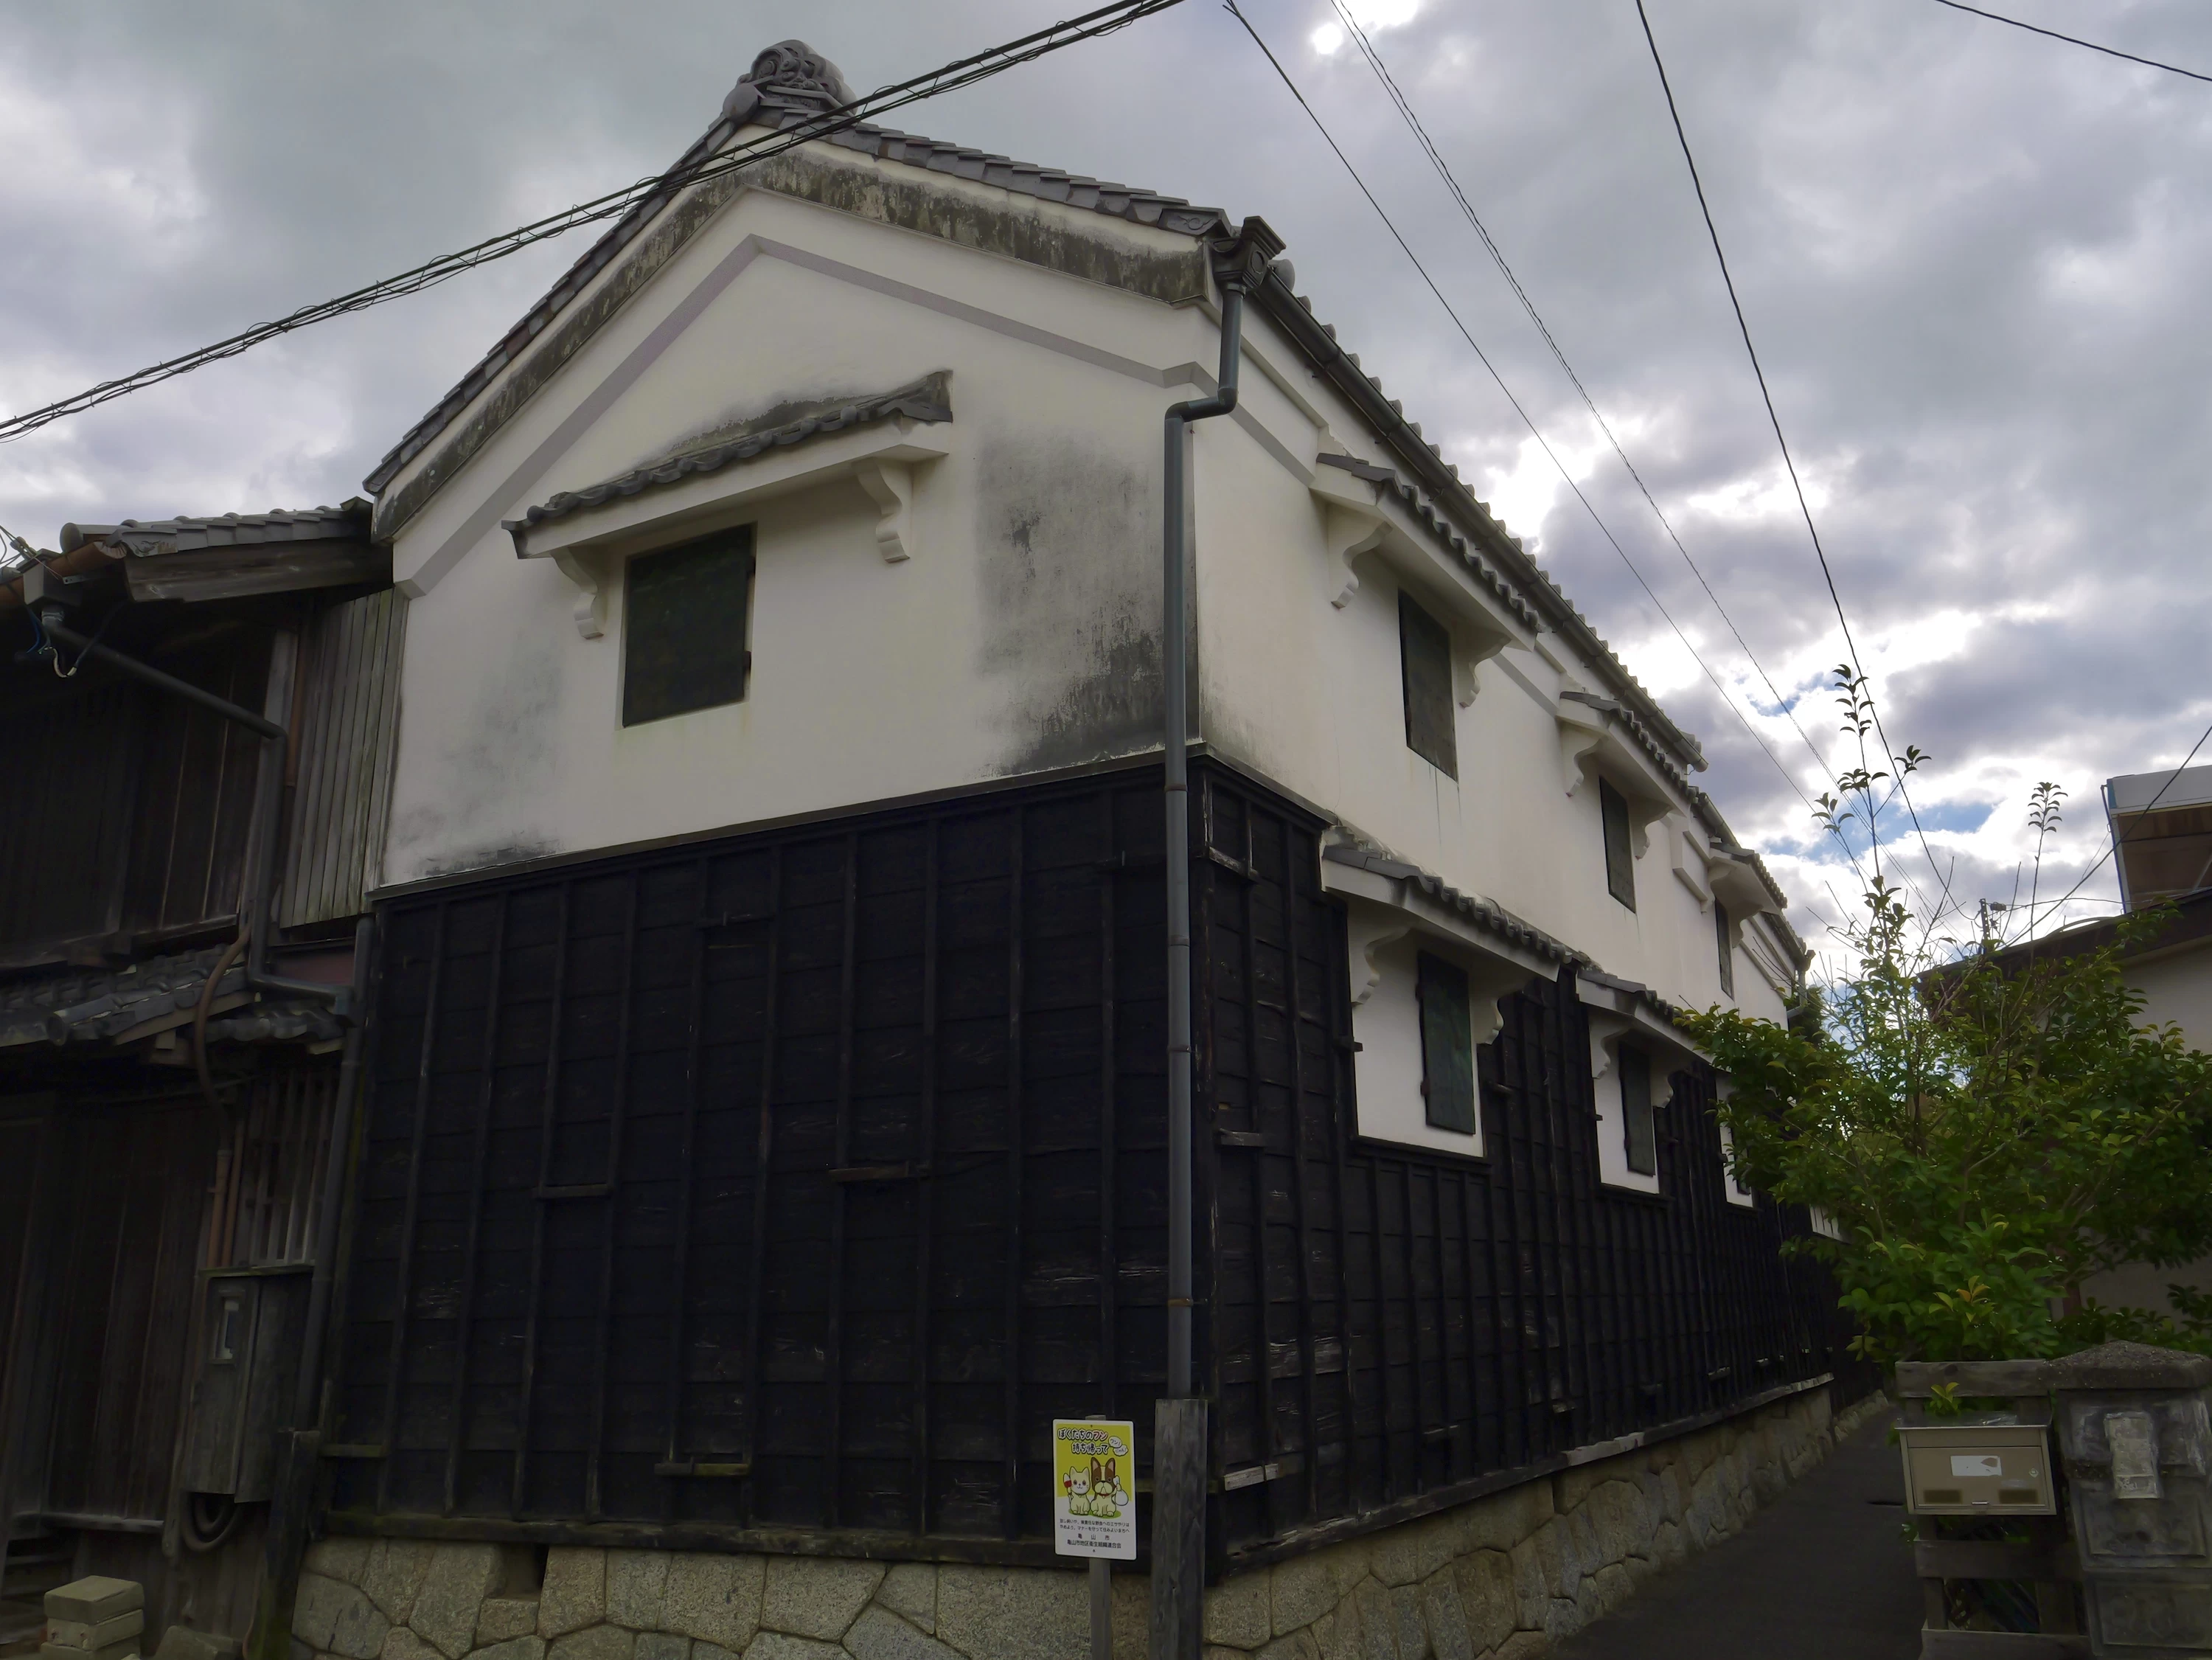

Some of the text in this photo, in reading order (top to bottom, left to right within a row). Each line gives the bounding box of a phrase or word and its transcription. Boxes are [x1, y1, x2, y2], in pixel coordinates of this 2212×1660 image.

[1058, 1428, 1107, 1441] ぼくたちのフン
[1072, 1442, 1108, 1455] 持ち帰って
